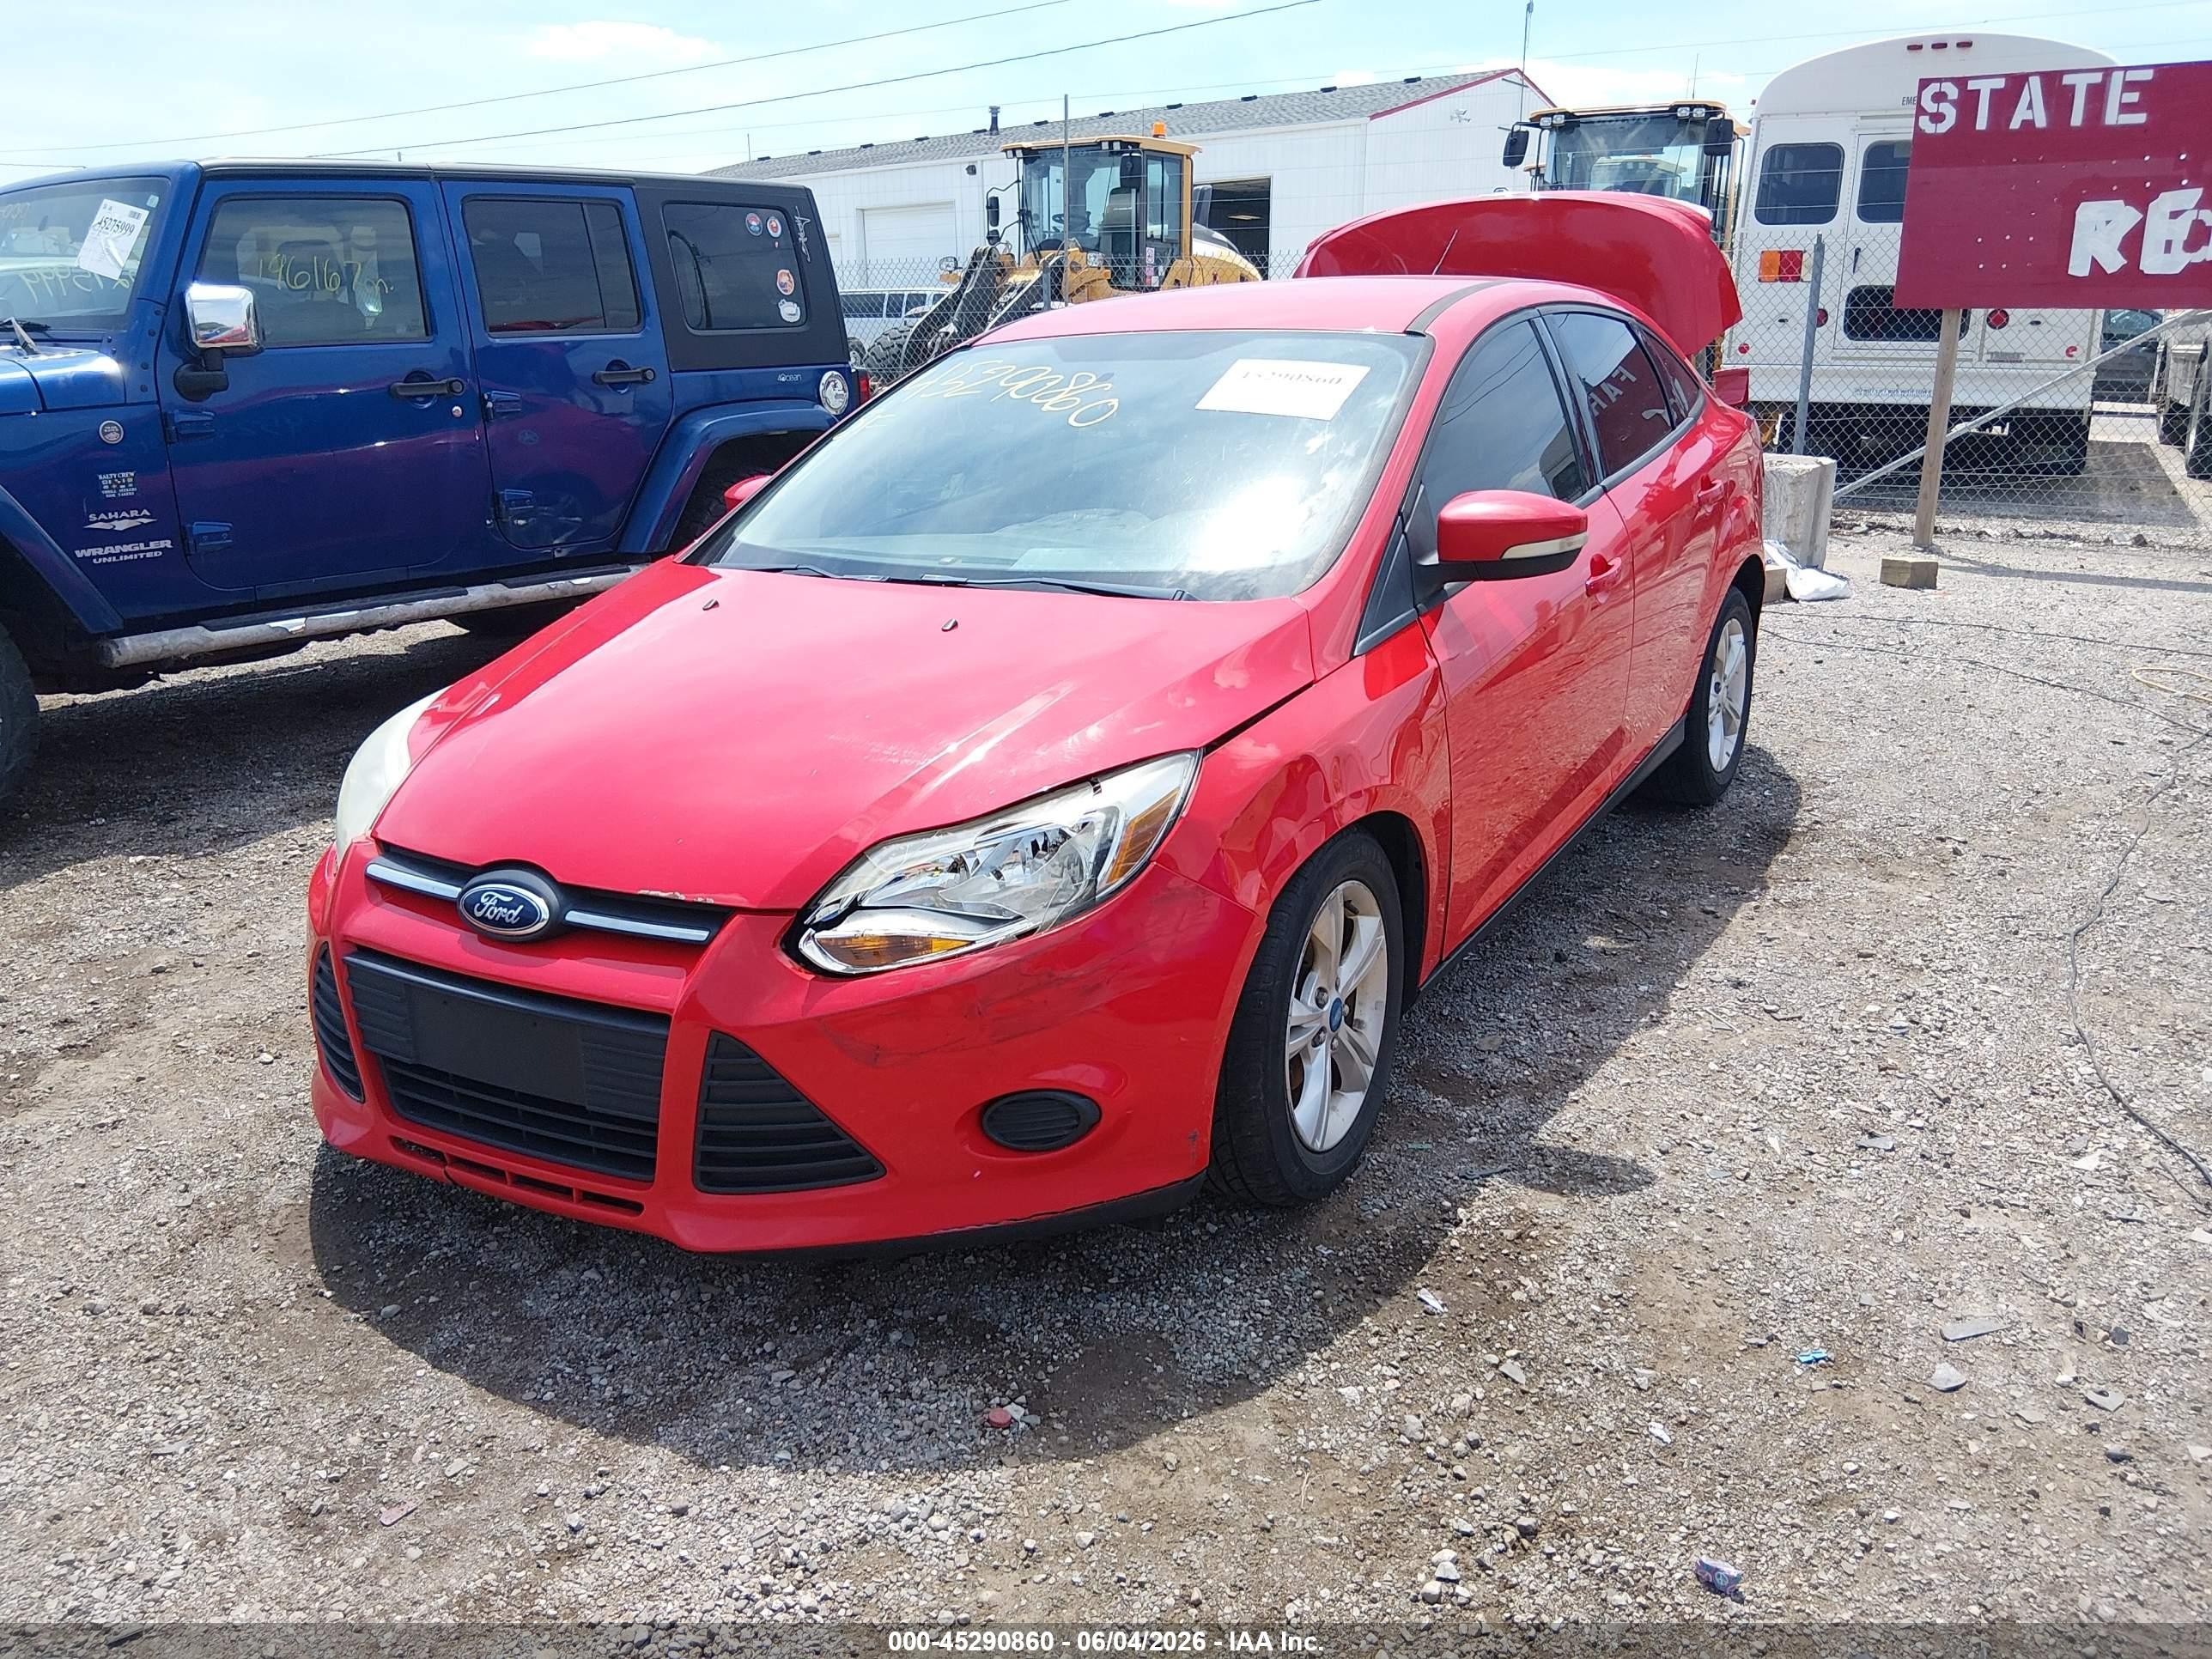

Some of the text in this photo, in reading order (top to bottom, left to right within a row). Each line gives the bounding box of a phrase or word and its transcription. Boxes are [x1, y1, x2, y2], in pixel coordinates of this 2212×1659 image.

[1918, 69, 2154, 134] STATE
[2068, 188, 2212, 276] REC
[88, 509, 151, 521] SAHARA
[75, 539, 173, 558] WRANGLER
[93, 550, 162, 564] UNLIMITED
[474, 891, 524, 924] Ford
